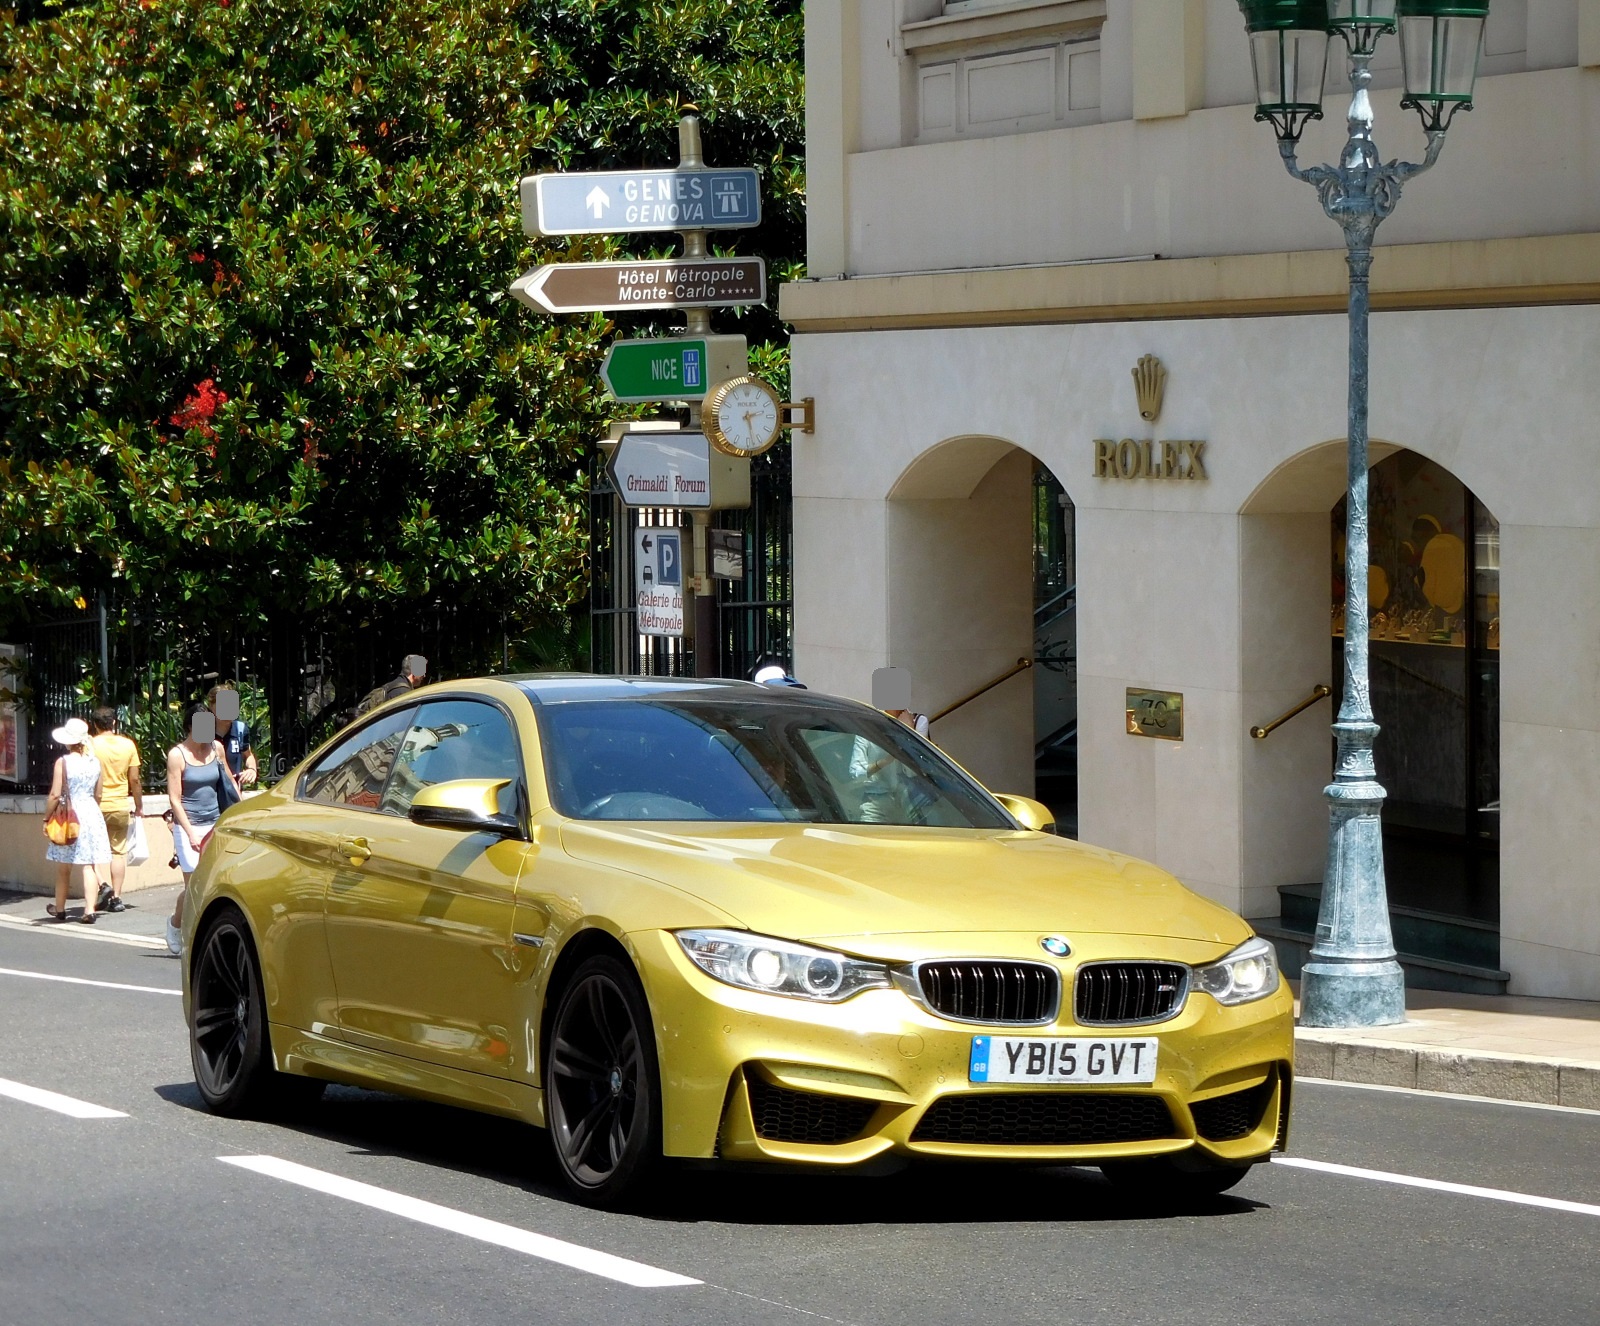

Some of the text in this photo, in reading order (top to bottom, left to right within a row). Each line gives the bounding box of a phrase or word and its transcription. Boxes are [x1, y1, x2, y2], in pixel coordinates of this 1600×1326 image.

[624, 177, 704, 201] GENES
[625, 203, 704, 223] GENOVA
[617, 267, 745, 285] Hôtel Métropole
[619, 284, 716, 301] Monte-Carlo
[651, 358, 678, 381] NICE
[1092, 438, 1208, 481] ROLEX
[627, 475, 706, 493] Grimaldi Forum
[638, 591, 682, 608] Galerie du
[639, 611, 682, 632] Métropole
[973, 1062, 987, 1072] GB
[1005, 1042, 1147, 1075] YB15 GVT
